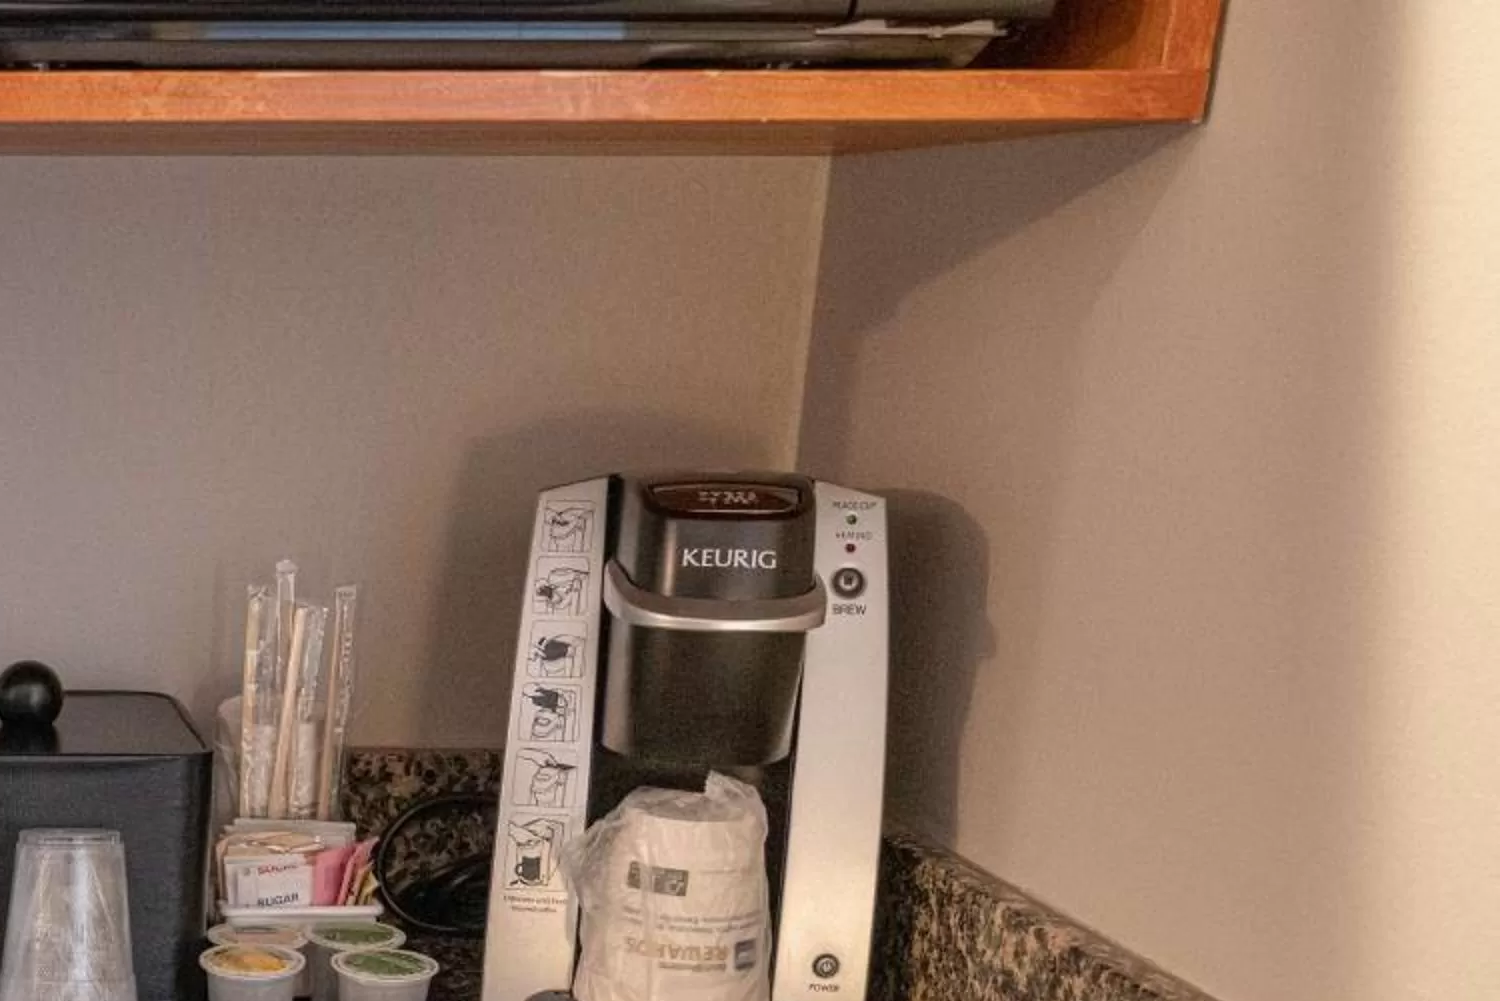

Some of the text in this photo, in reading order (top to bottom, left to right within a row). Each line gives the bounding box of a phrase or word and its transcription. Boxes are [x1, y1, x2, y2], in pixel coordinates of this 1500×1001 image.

[682, 548, 777, 570] KEURIG
[832, 603, 867, 616] BREW
[257, 892, 300, 907] SUGAR
[808, 983, 841, 993] POWER
